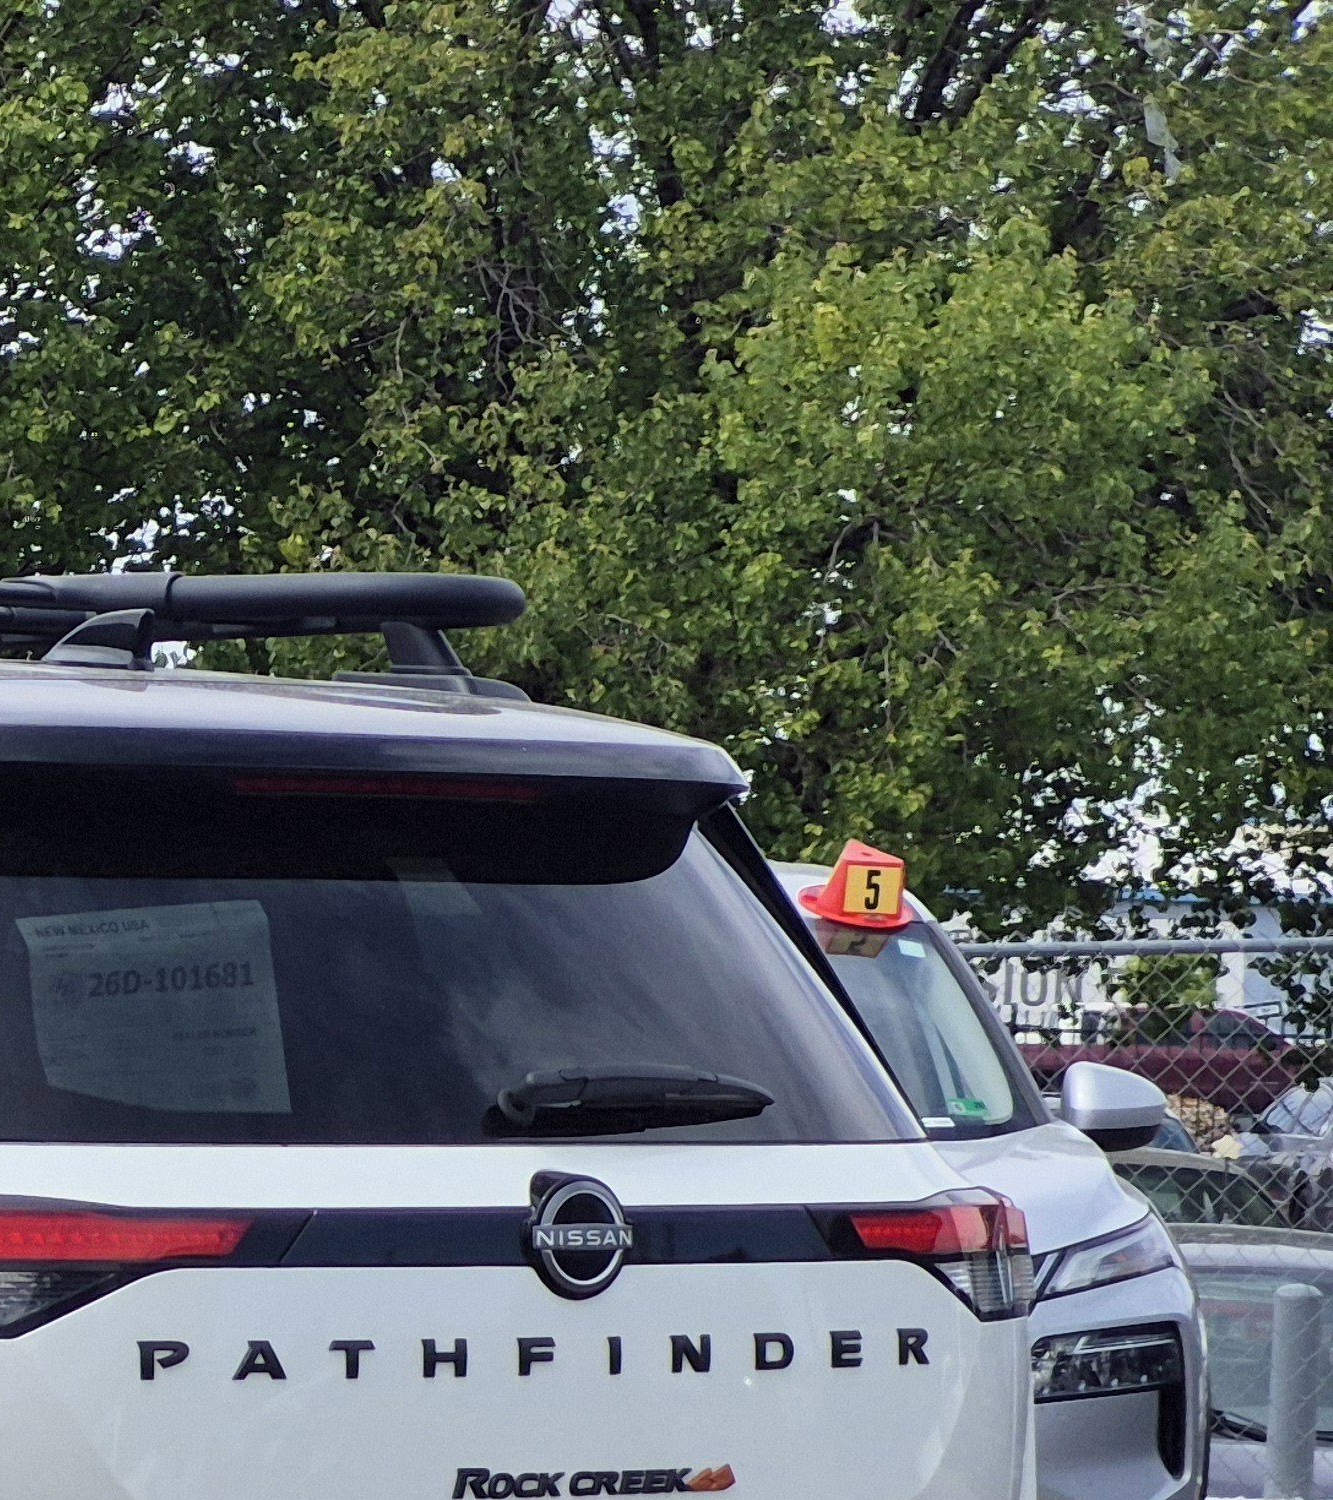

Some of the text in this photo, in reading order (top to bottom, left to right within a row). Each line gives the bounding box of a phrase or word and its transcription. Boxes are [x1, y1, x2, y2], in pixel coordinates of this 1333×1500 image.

[865, 870, 881, 909] 5
[534, 1226, 632, 1250] NISSAN
[138, 1328, 930, 1382] PATHFINDER
[569, 1467, 692, 1497] CREEK
